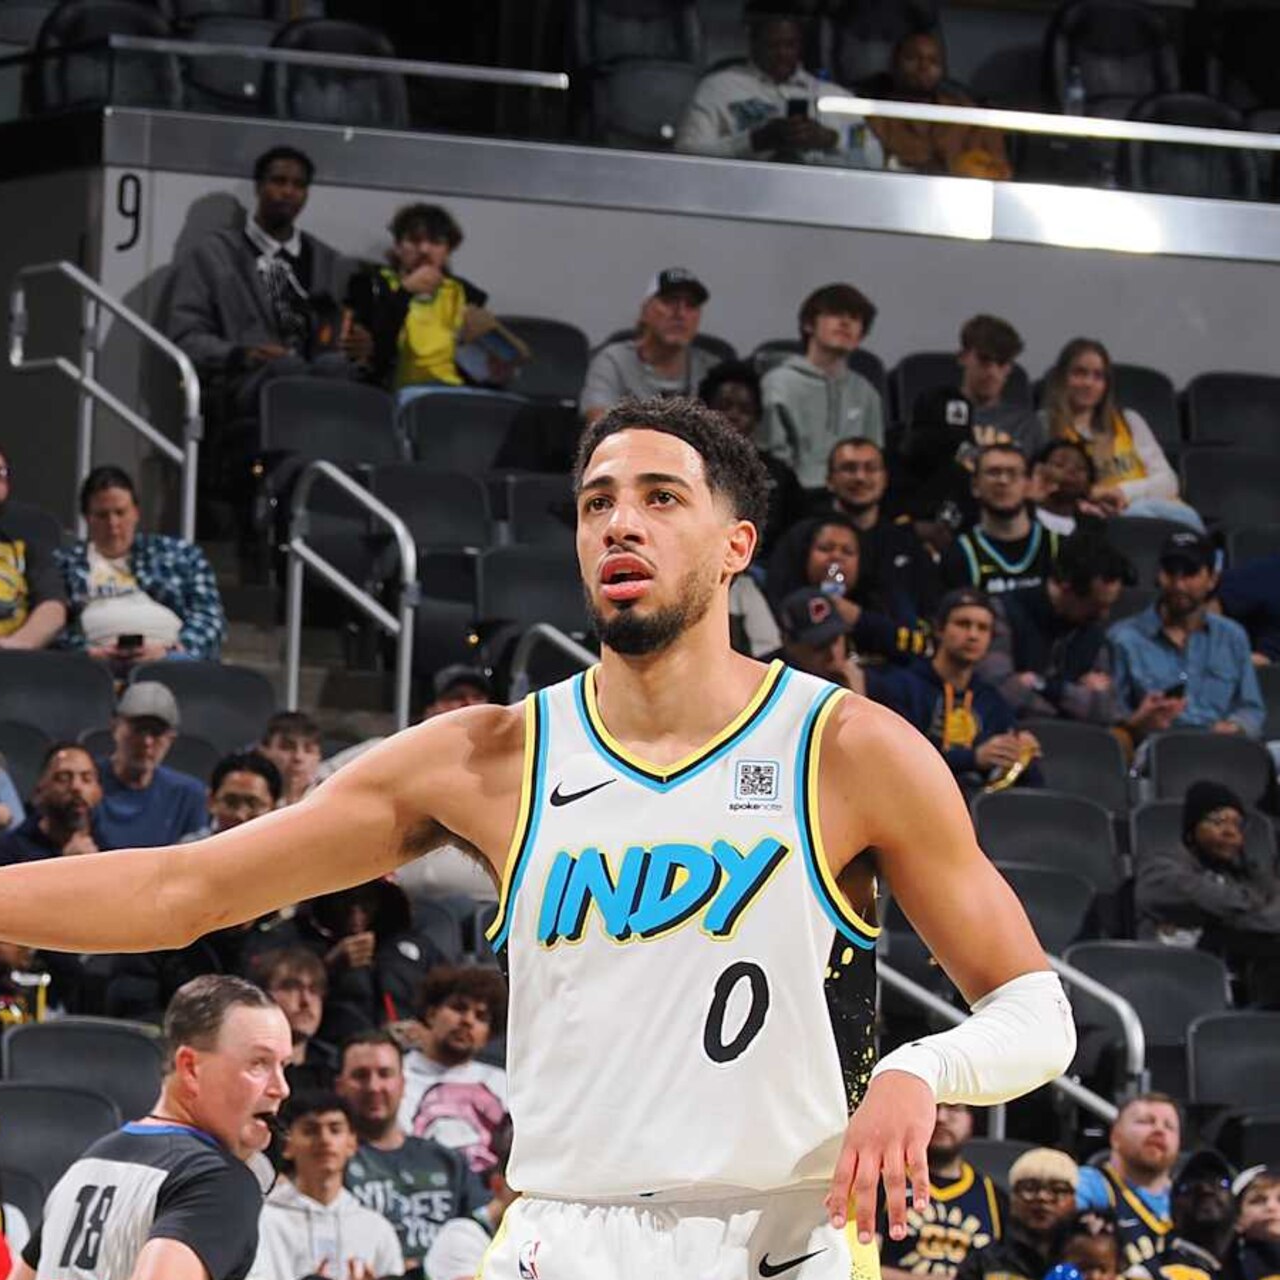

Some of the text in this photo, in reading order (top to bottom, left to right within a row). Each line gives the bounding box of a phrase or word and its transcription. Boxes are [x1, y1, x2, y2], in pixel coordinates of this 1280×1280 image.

[116, 174, 141, 252] 9
[537, 837, 789, 948] INDY
[704, 961, 770, 1064] 0
[59, 1185, 117, 1270] 18
